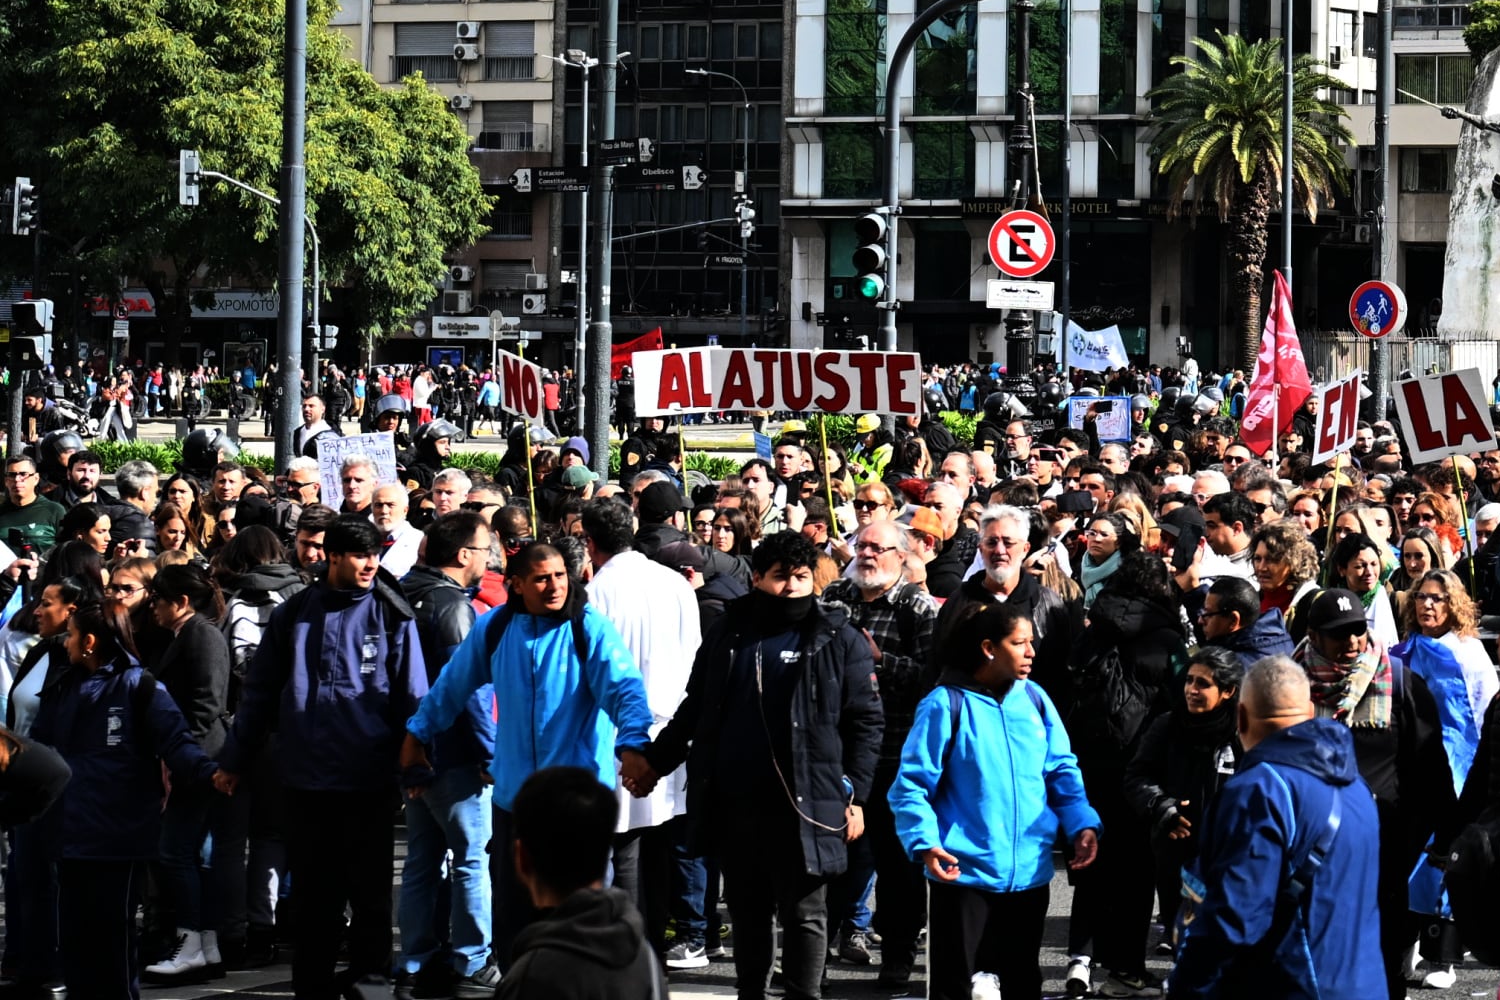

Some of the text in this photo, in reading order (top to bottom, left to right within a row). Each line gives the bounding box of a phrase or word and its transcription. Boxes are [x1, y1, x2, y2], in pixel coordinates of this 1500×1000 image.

[642, 168, 674, 176] Obelisco
[503, 355, 539, 419] NO
[657, 352, 712, 410] AL
[718, 351, 917, 415] AJUSTE
[1402, 373, 1493, 452] LA
[1319, 376, 1359, 455] EN
